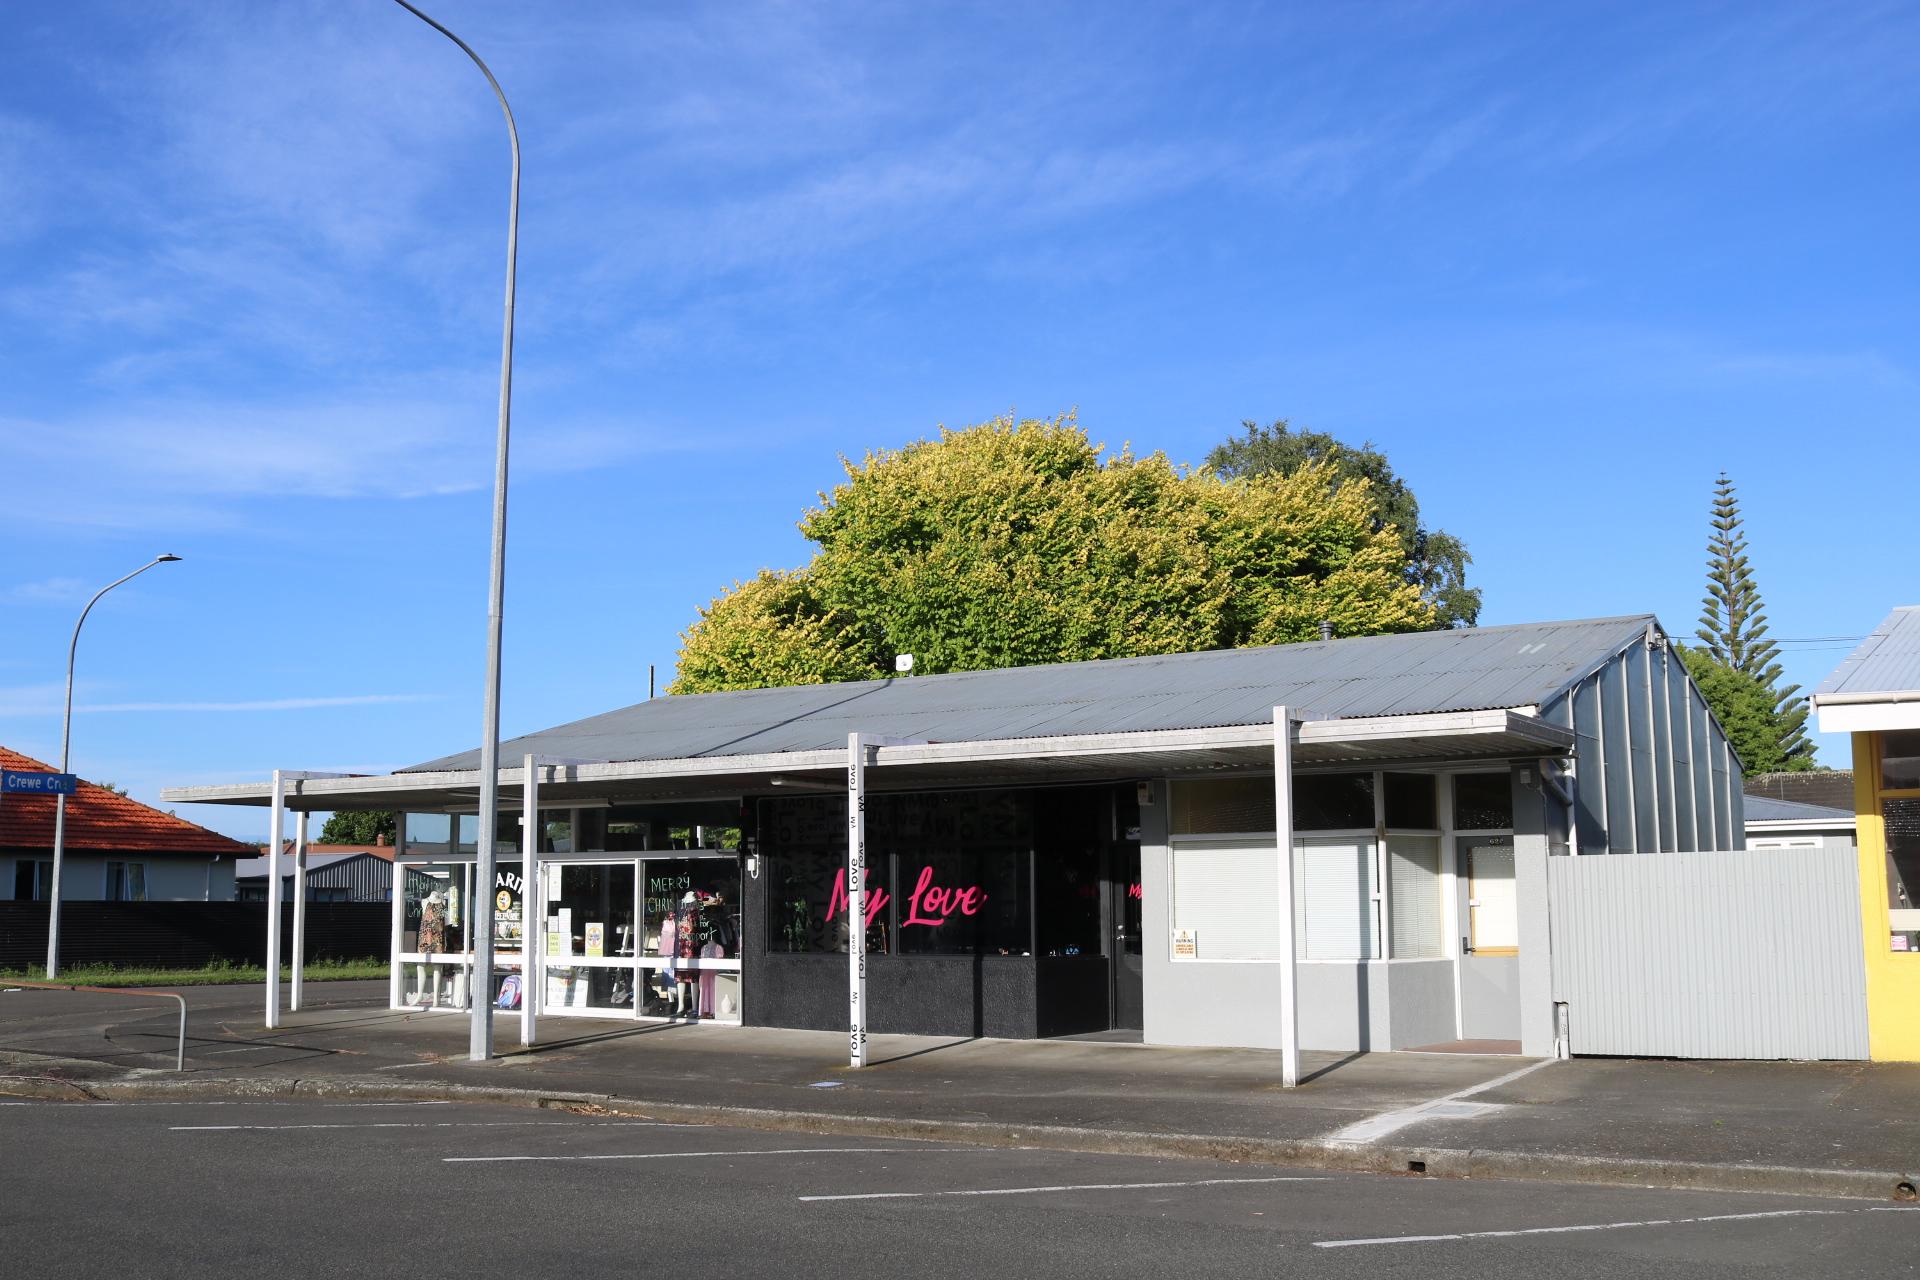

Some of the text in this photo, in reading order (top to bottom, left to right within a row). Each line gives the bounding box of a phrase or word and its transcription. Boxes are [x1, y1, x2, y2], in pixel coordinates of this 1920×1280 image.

[8, 775, 41, 788] Crewe
[825, 866, 988, 928] My Love
